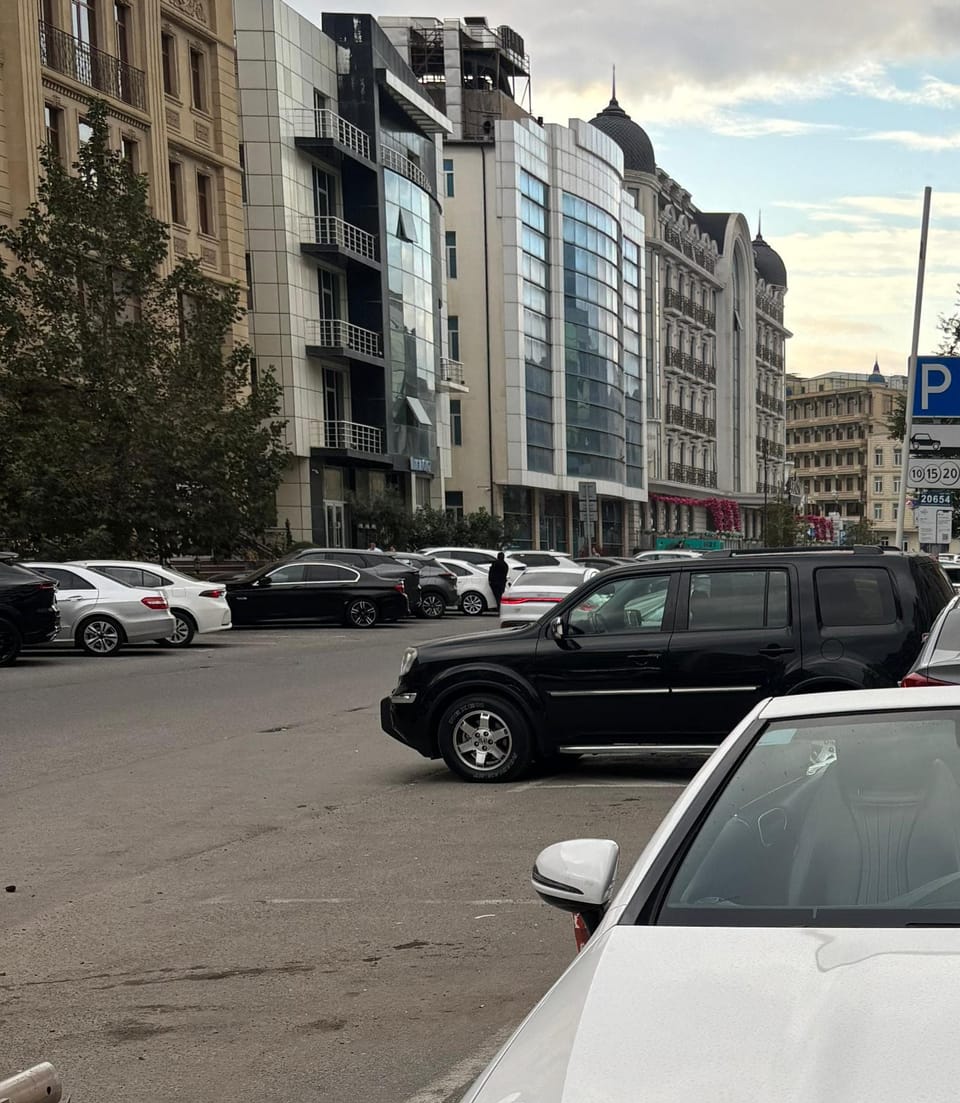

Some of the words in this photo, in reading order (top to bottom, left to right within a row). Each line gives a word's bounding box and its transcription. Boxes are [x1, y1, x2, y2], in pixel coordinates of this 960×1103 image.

[921, 363, 952, 410] P
[912, 469, 923, 479] 10
[927, 468, 938, 479] 15
[943, 468, 958, 479] 20
[921, 494, 951, 504] 20654
